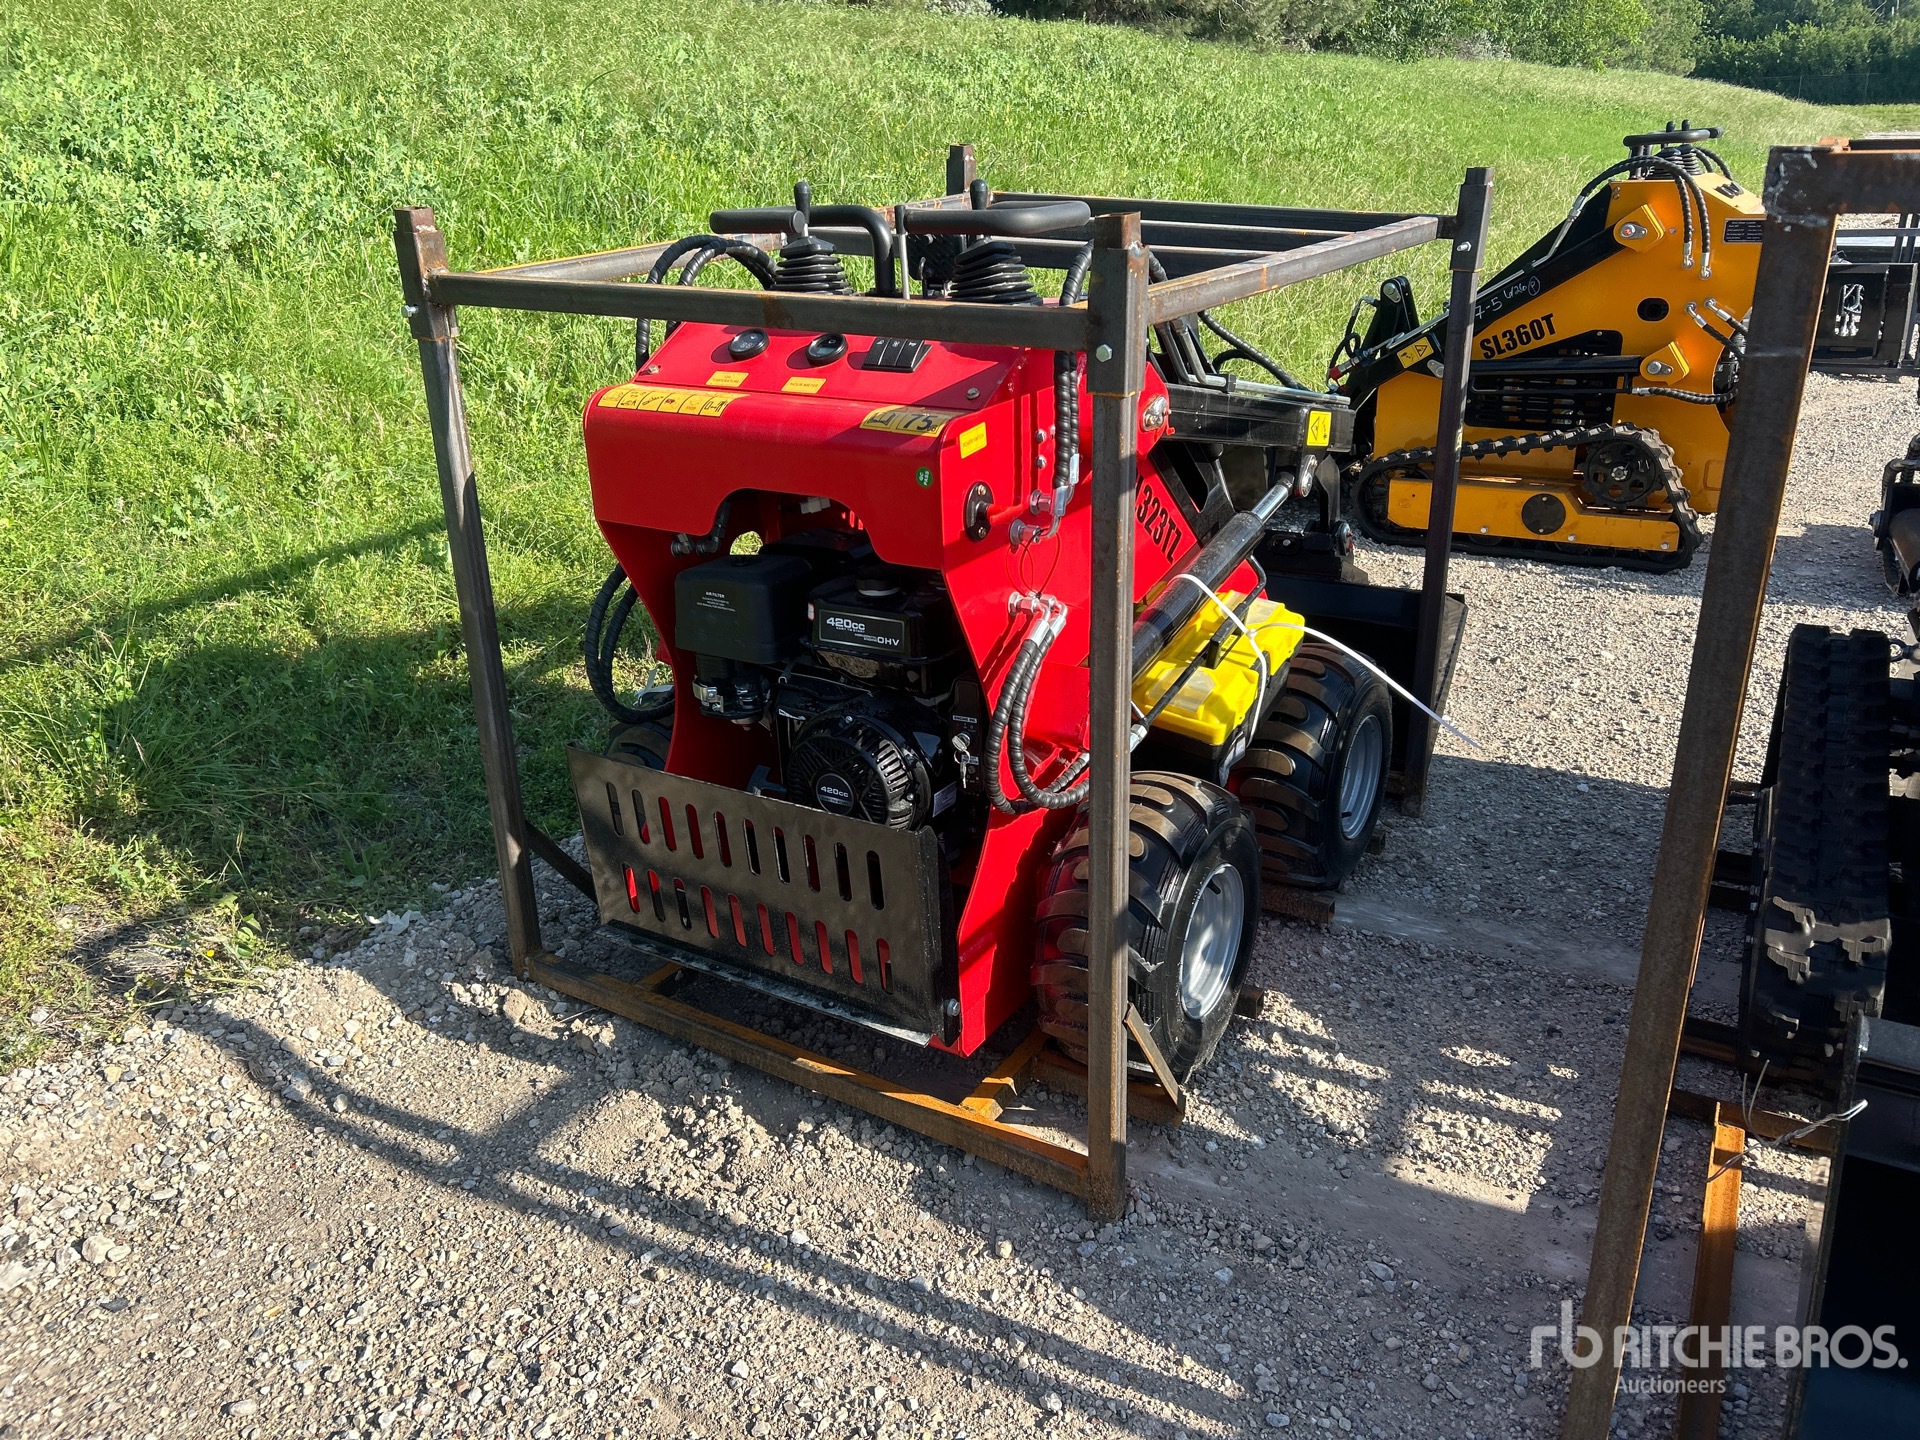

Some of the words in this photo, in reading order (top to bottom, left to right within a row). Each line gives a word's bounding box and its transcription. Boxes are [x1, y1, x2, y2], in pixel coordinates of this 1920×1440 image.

[1479, 312, 1556, 360] SL360T
[903, 413, 938, 431] 75
[826, 617, 866, 630] 420cc
[877, 636, 900, 646] OHV
[820, 786, 849, 798] 420cc
